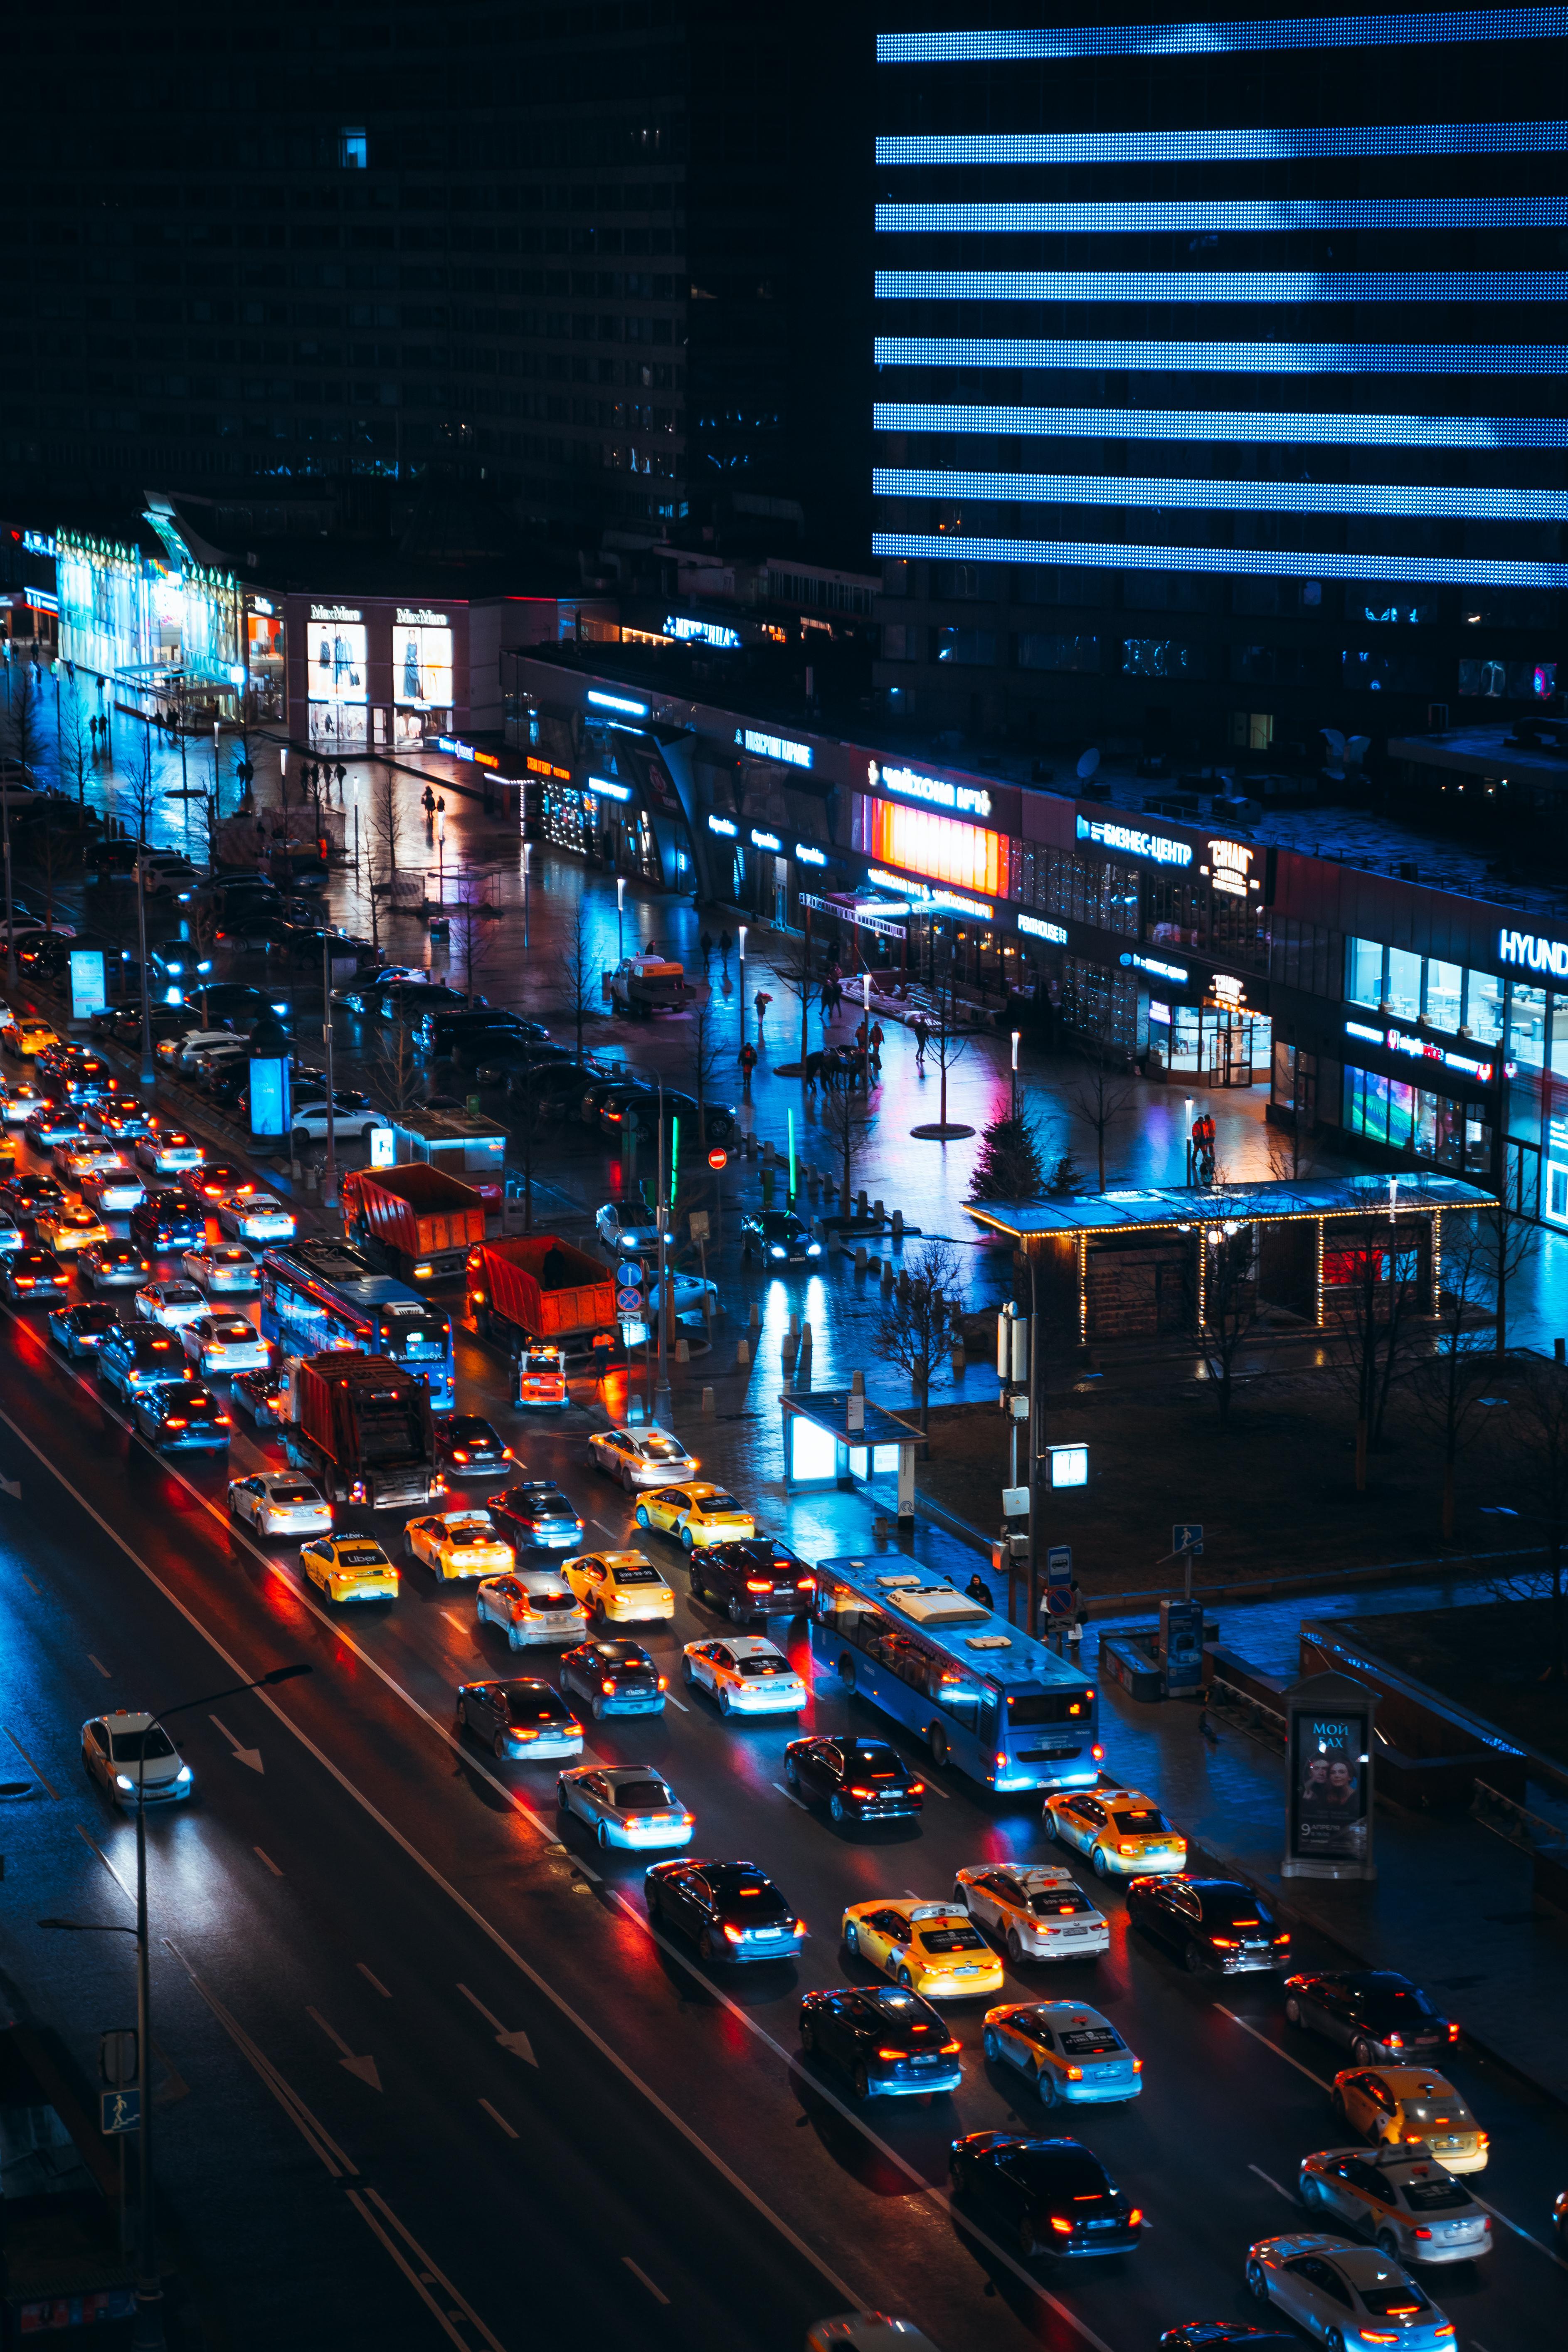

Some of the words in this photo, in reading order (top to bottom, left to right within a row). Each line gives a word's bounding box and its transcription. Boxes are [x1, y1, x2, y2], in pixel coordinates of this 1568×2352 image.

[311, 604, 360, 621] MaxMara
[396, 608, 447, 625] MaxMara
[745, 730, 782, 758] MUSICPOINT
[1104, 823, 1192, 865] БИЗНЕС-ЦЕНТР
[1018, 914, 1059, 942] PENTHOUSE
[1501, 929, 1568, 975] HYUND
[533, 1501, 547, 1511] Z
[1312, 1722, 1349, 1736] МОЙ
[1301, 1824, 1311, 1835] 9
